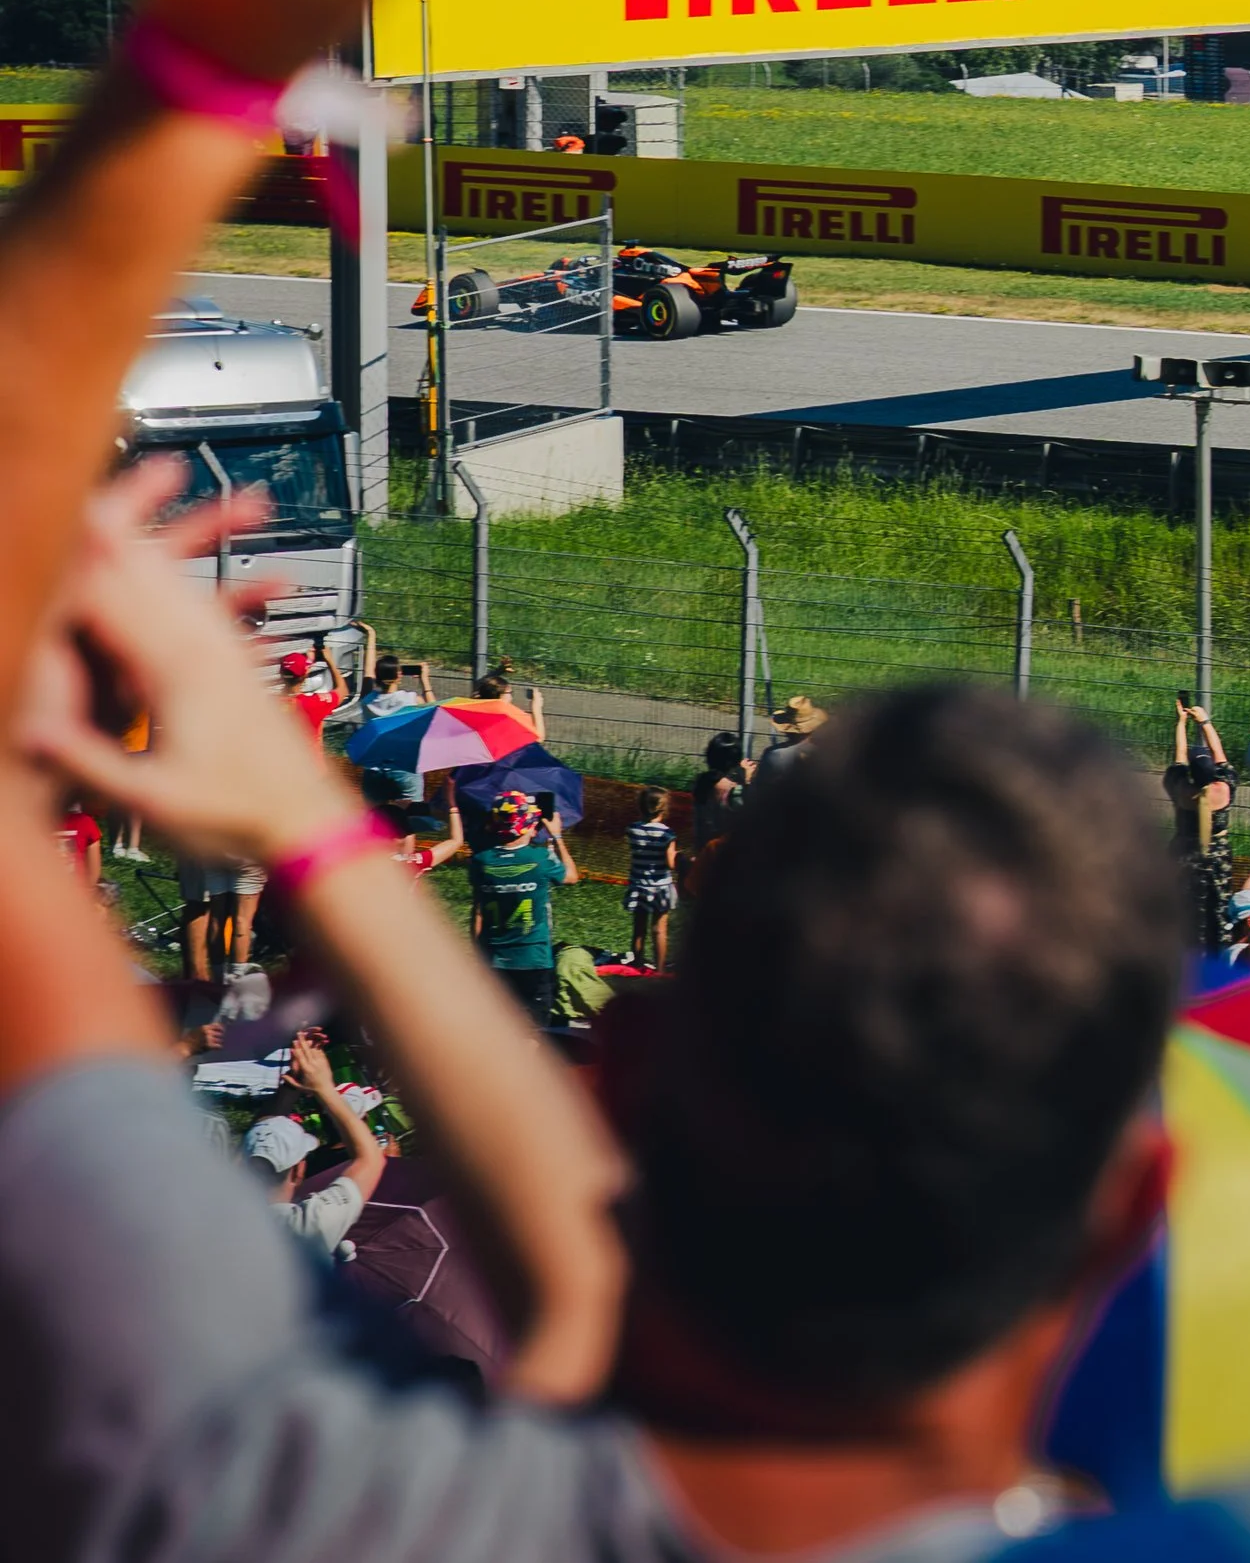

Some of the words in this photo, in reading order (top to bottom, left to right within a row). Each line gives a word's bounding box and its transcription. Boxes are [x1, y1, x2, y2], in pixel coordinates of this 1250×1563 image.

[738, 178, 917, 245] PIRELLI
[1042, 196, 1228, 267] PIRELLI
[484, 898, 536, 935] 14
